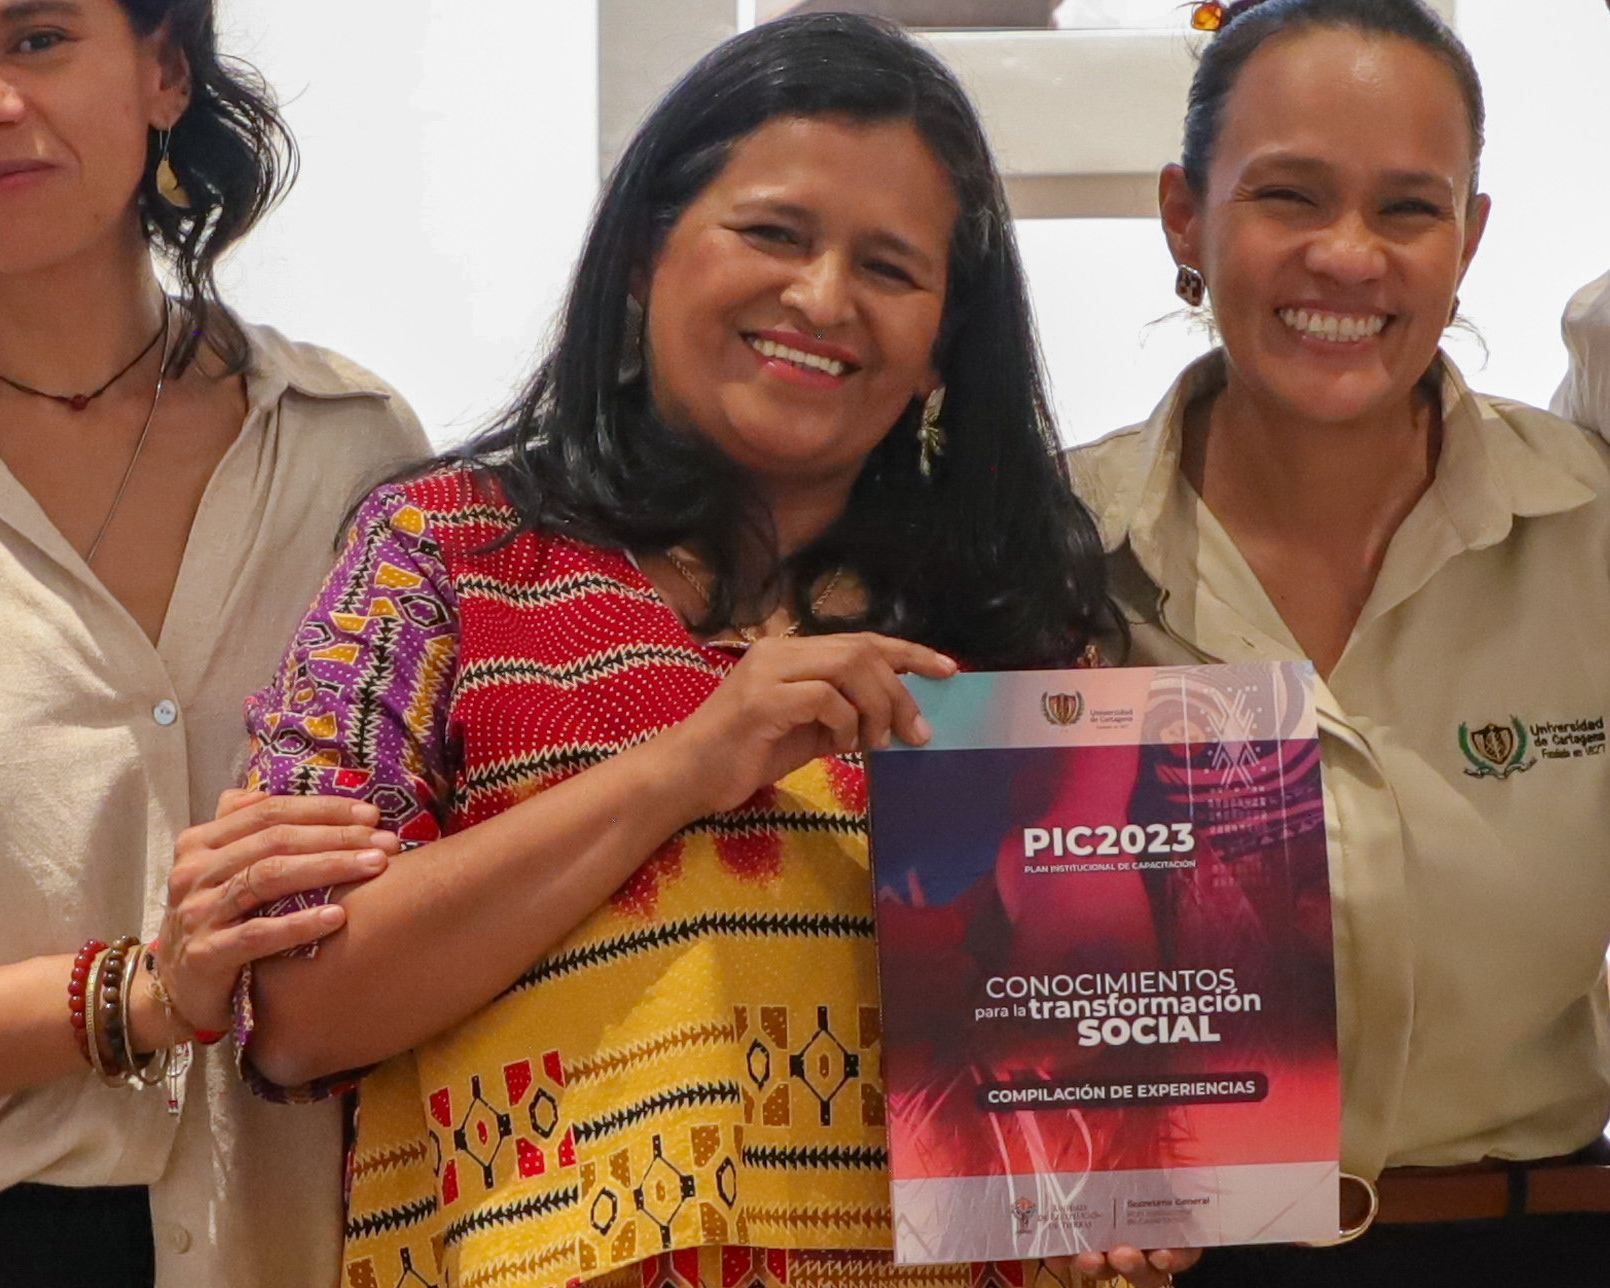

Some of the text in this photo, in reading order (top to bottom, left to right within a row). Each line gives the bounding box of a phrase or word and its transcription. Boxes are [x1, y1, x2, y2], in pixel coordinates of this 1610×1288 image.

[1530, 716, 1604, 736] Universidad
[1534, 736, 1548, 747] de
[1023, 823, 1195, 858] PIC2023
[1024, 864, 1048, 874] PLAN
[1118, 863, 1131, 871] DE
[986, 968, 1236, 999] CONOCIMIENTOS
[975, 987, 1262, 1022] para la transformación
[1077, 1014, 1222, 1047] SOCIAL
[988, 1080, 1256, 1103] COMPILACIÓN DE EXPERIENCIAS
